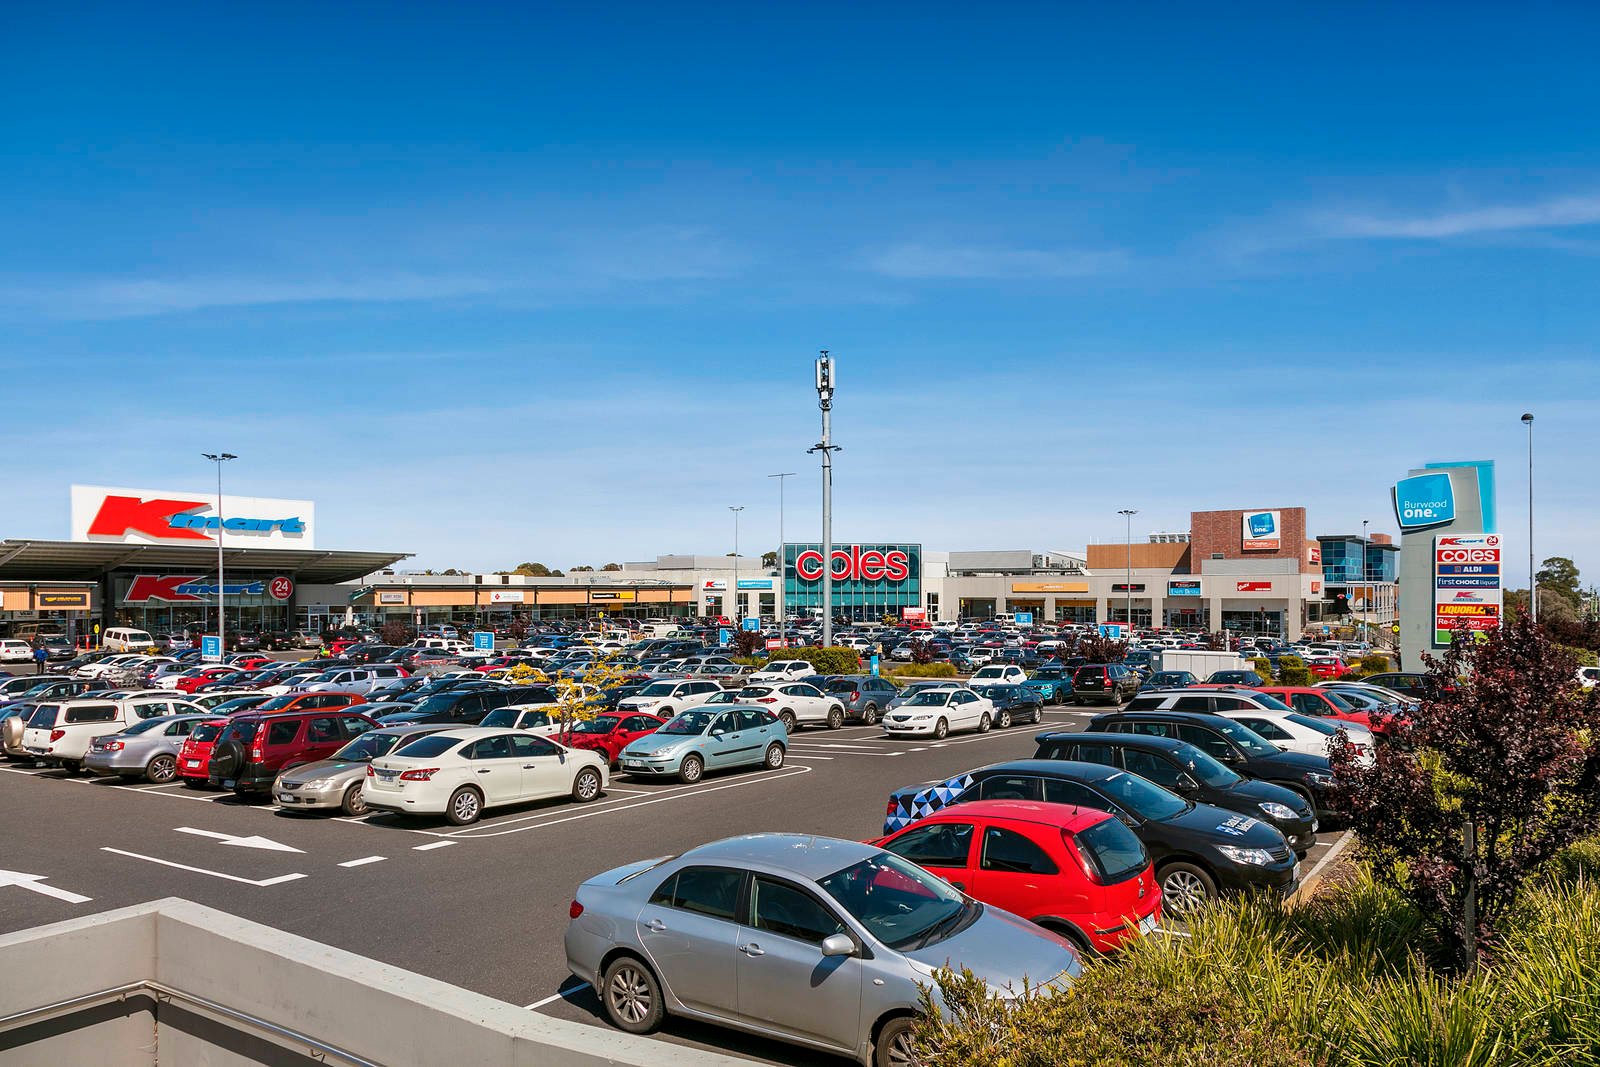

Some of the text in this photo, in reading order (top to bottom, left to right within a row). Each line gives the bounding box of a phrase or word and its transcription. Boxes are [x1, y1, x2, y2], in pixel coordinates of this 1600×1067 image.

[1404, 500, 1447, 509] Burwood
[87, 495, 306, 543] Kmart
[1403, 508, 1438, 518] one.
[1441, 549, 1496, 562] coles
[796, 545, 909, 580] coles
[123, 575, 266, 602] Kmart
[275, 580, 288, 591] 24
[1439, 605, 1498, 615] LIQUORLA
